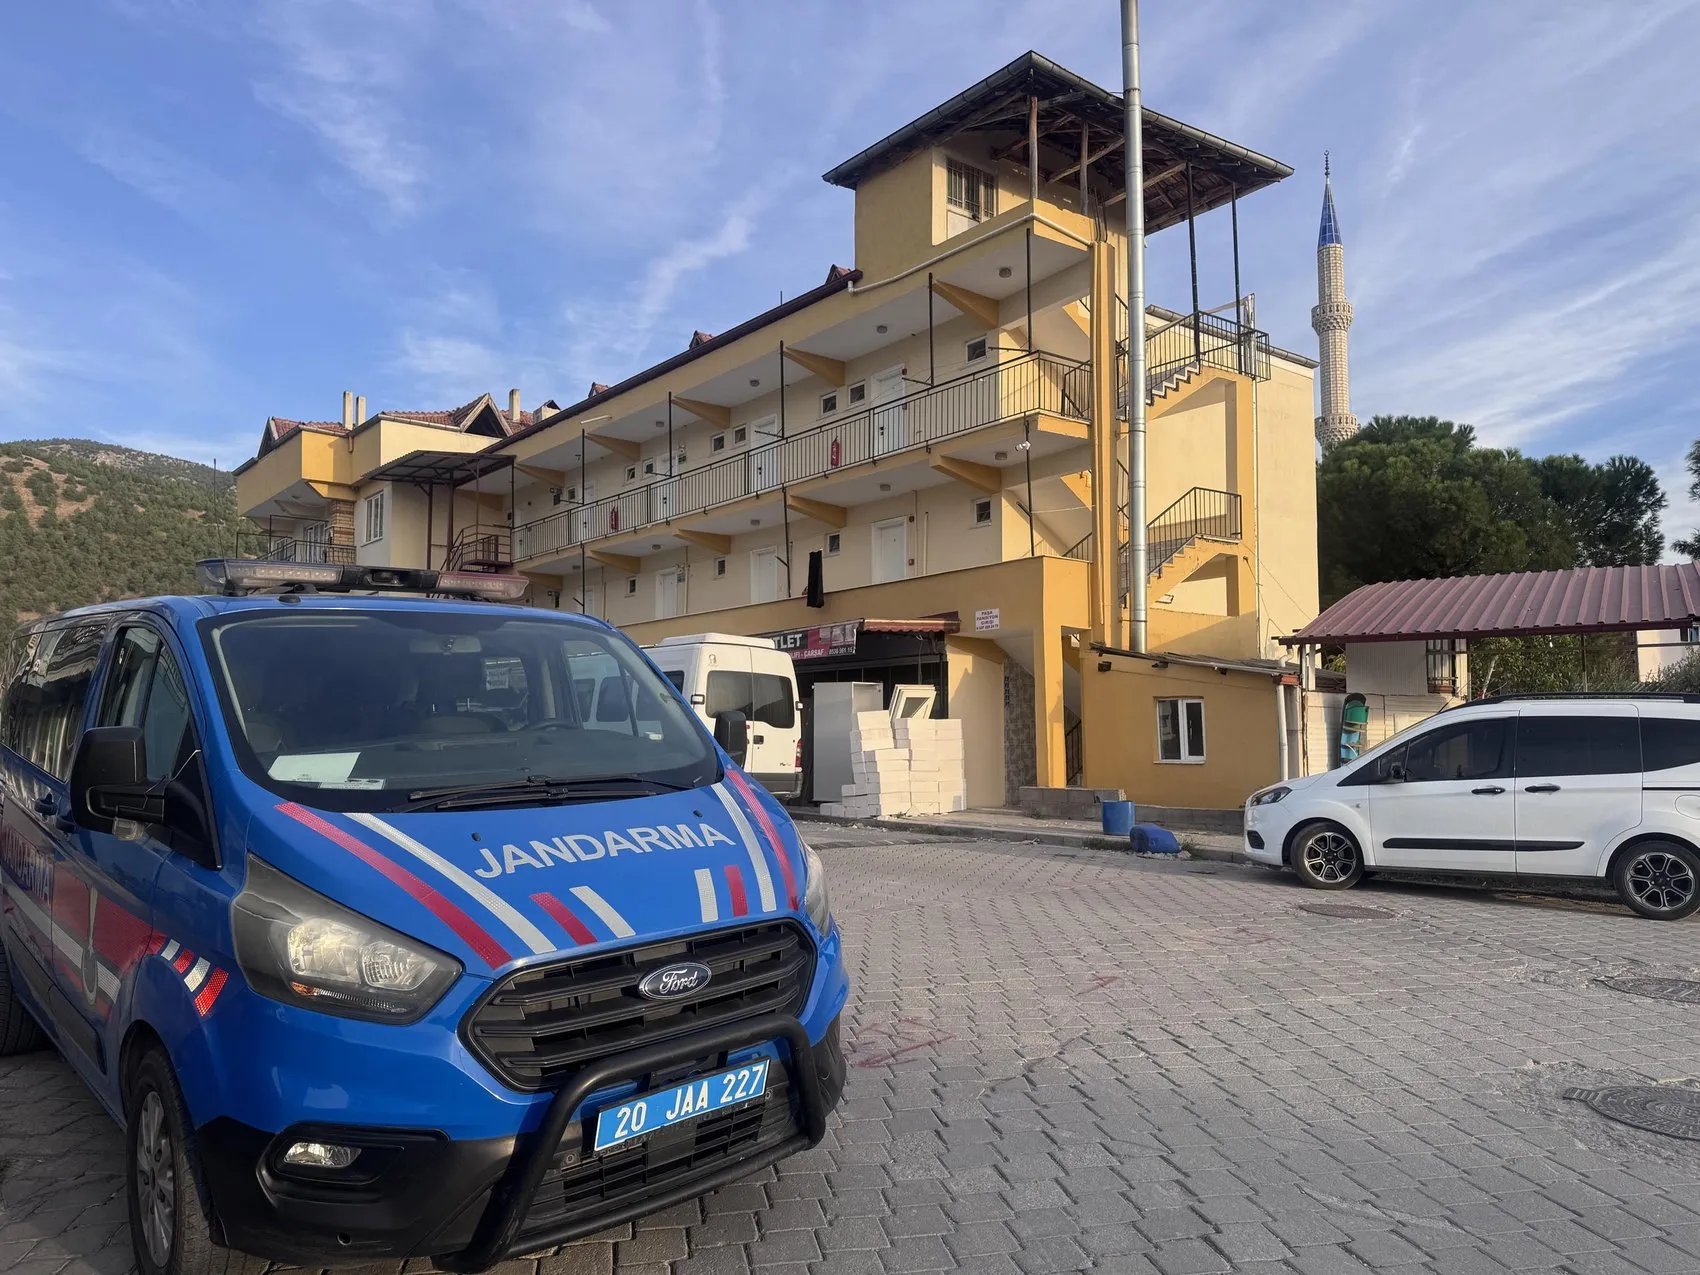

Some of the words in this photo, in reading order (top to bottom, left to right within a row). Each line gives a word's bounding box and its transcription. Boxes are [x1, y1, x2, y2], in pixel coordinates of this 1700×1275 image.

[474, 823, 736, 879] JANDARMA
[659, 968, 698, 994] Ford
[614, 1102, 647, 1139] 20
[666, 1080, 709, 1120] JAA
[720, 1063, 765, 1104] 227
